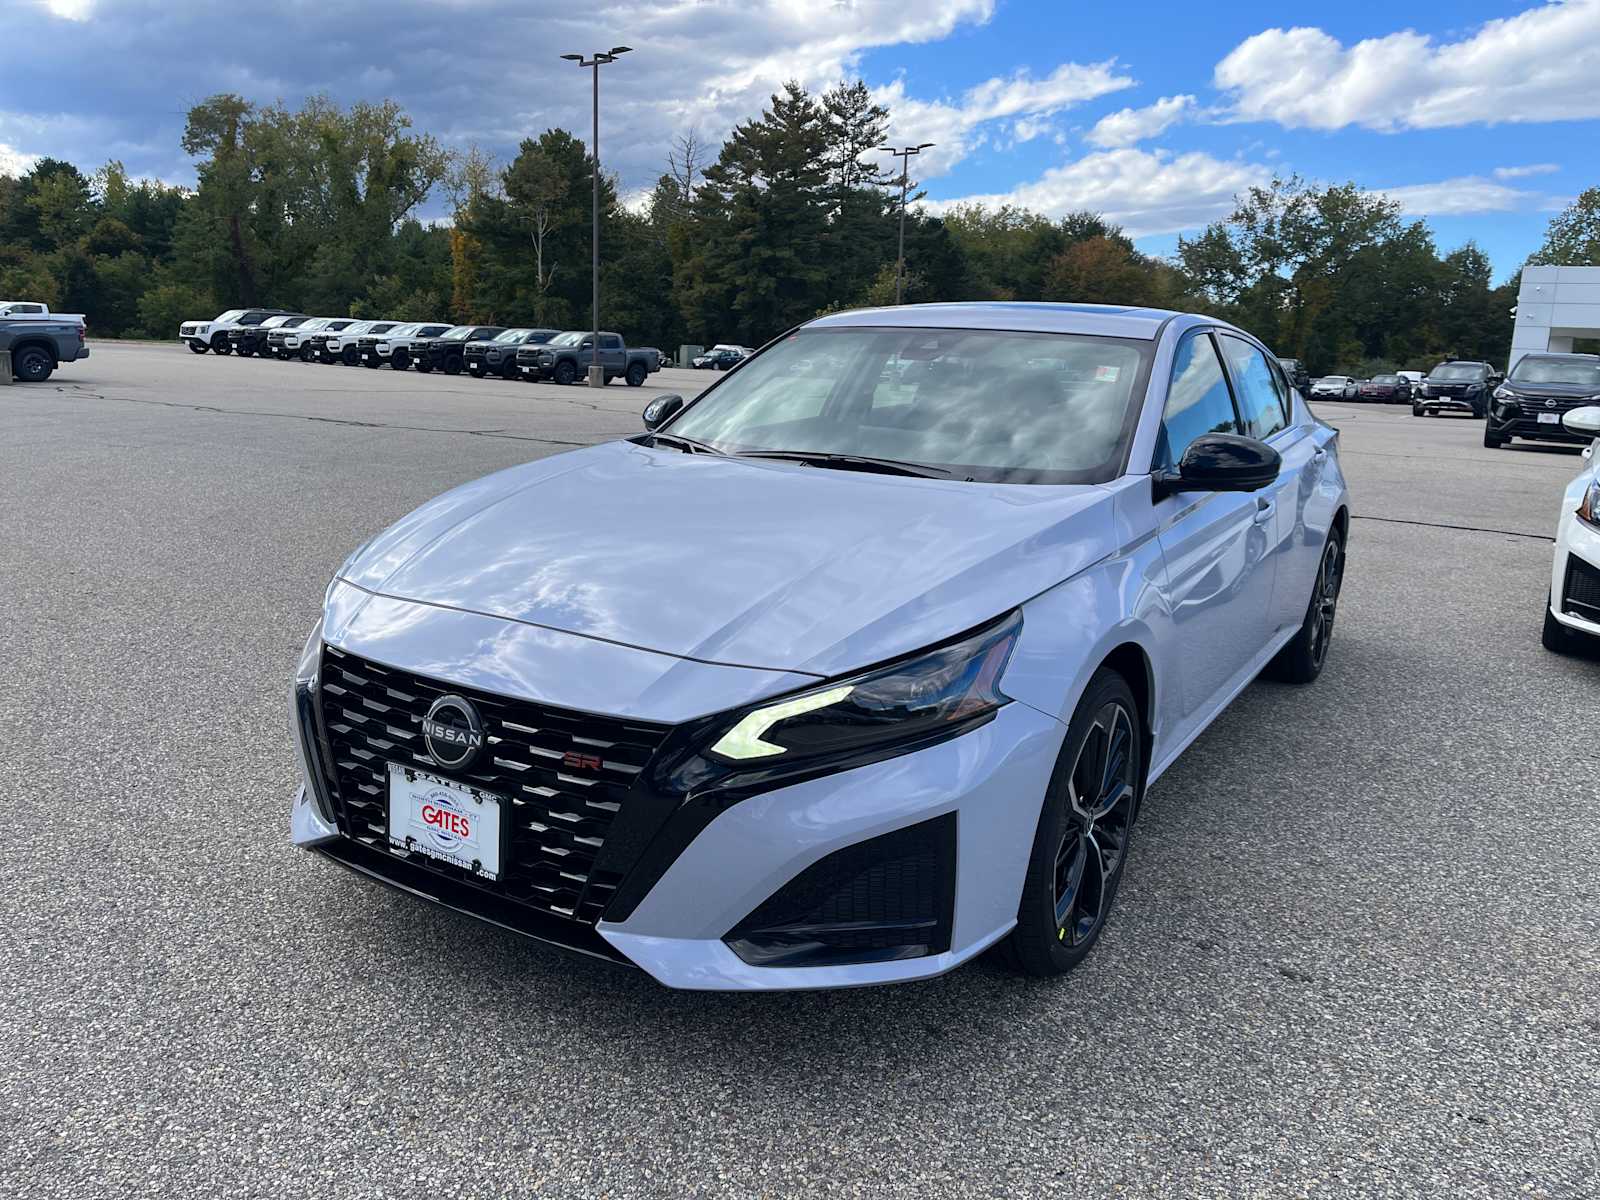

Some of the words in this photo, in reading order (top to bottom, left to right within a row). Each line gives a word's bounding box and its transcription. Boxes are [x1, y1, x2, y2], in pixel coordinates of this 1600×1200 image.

[422, 720, 482, 746] NISSAN
[564, 751, 601, 770] SR
[414, 771, 472, 794] GATES
[422, 805, 469, 837] GATES
